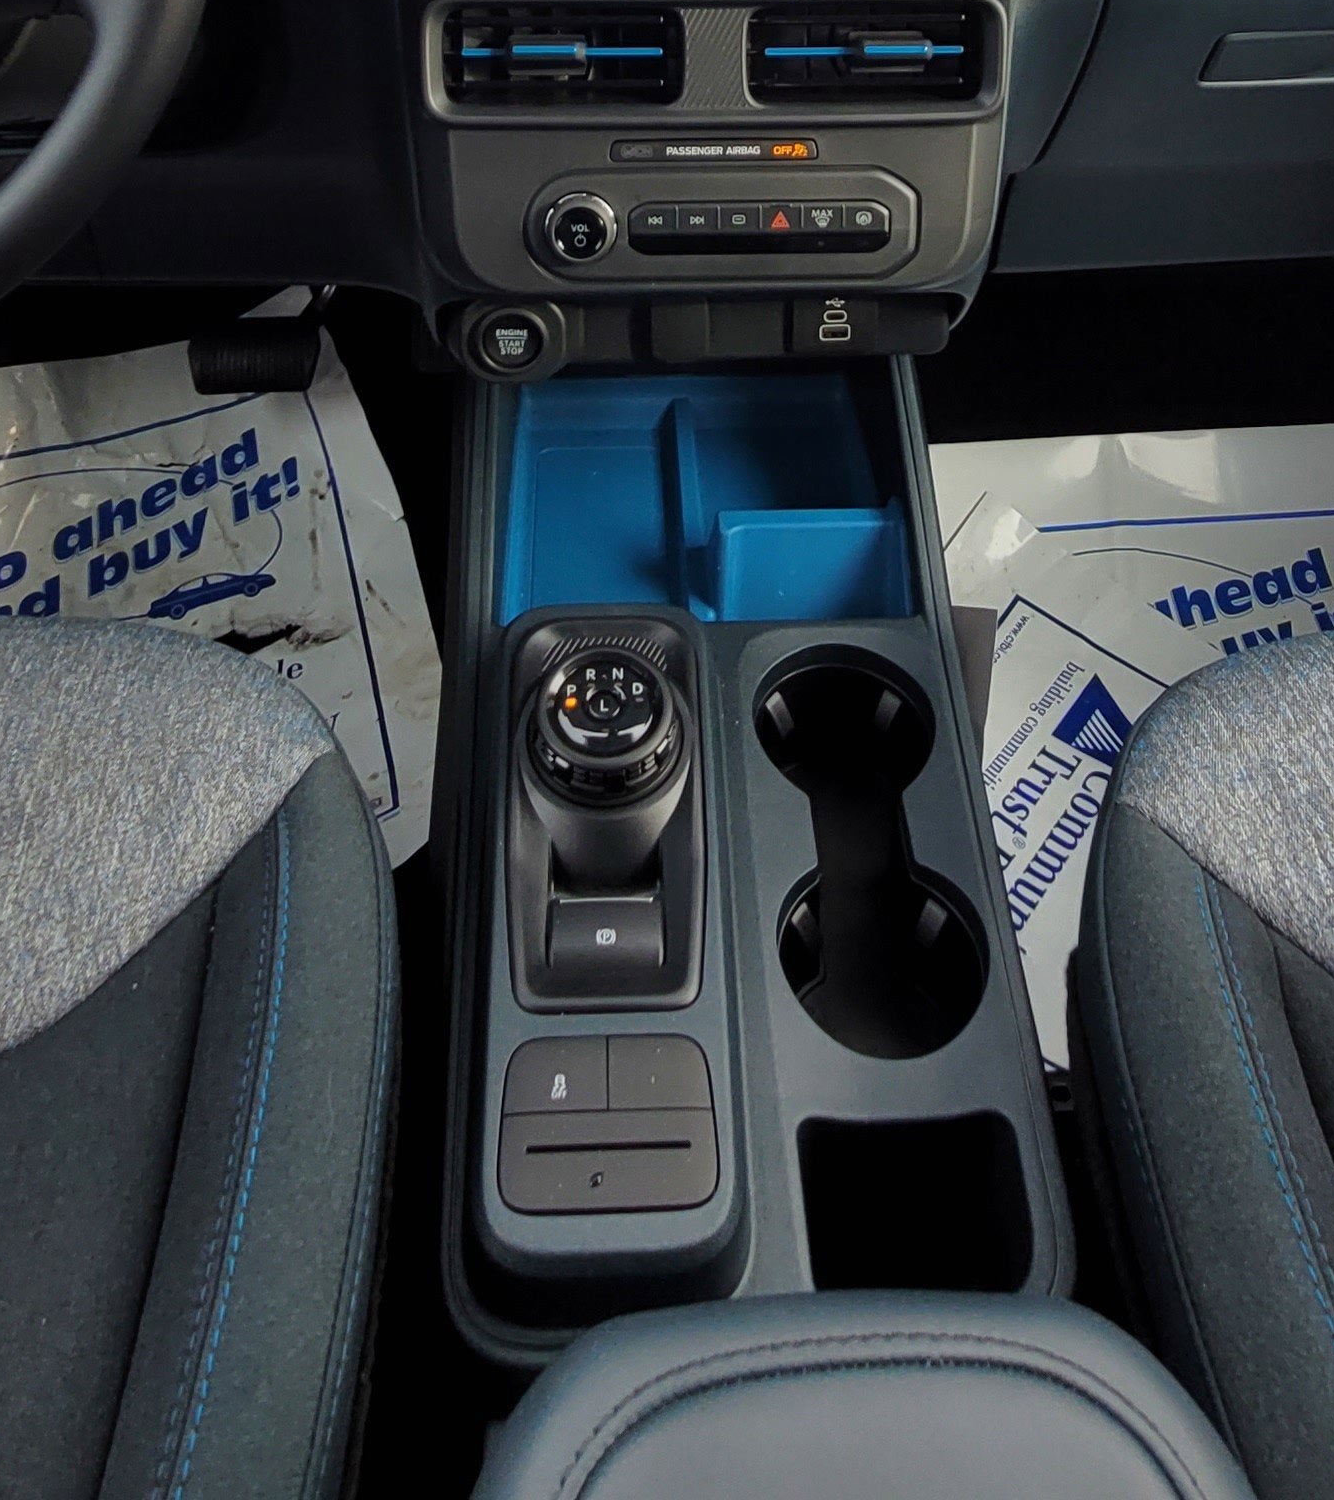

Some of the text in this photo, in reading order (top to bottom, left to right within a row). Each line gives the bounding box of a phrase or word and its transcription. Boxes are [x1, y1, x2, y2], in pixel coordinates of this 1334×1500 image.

[666, 145, 761, 156] PASSENGER AIRBAG
[773, 145, 792, 155] OFF
[811, 209, 833, 218] MAX
[570, 223, 590, 232] VOL
[499, 340, 525, 348] START
[500, 347, 524, 355] STOP
[53, 427, 261, 563] ahead
[87, 506, 209, 598] buy
[231, 456, 301, 526] it!
[586, 668, 596, 680] R
[612, 667, 624, 680] N
[567, 684, 577, 697] P
[632, 682, 644, 696] D
[600, 698, 609, 712] L
[983, 660, 1085, 791] building communiti
[1008, 769, 1112, 932] Commun
